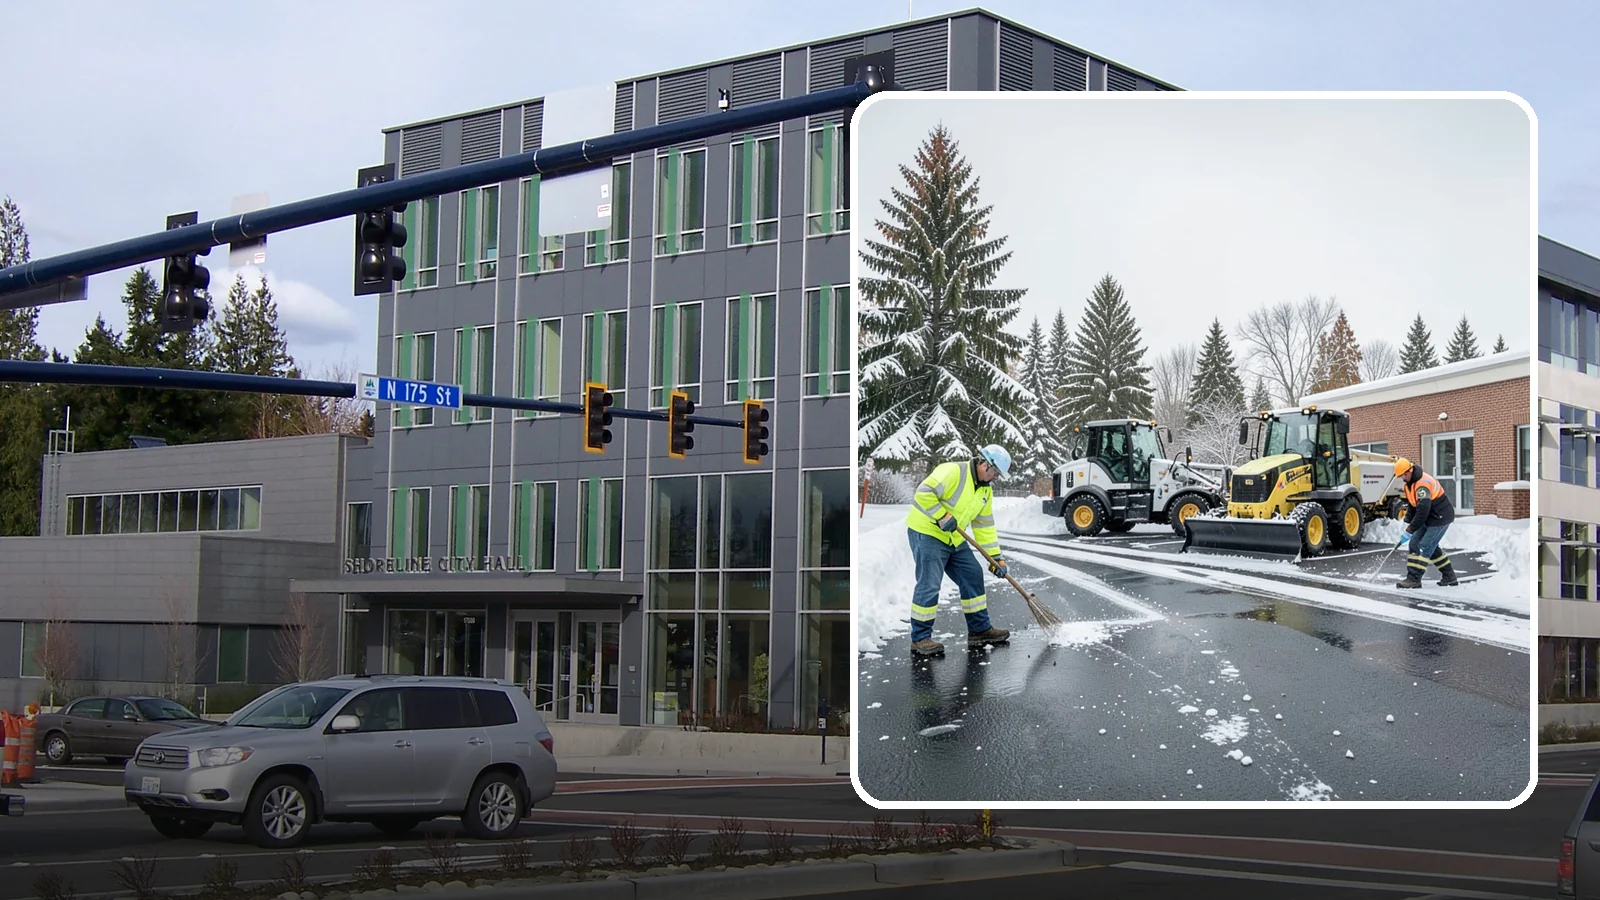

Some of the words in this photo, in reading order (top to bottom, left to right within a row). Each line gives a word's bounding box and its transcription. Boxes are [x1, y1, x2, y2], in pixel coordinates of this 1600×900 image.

[387, 380, 396, 400] N
[405, 382, 427, 403] 175
[436, 386, 451, 406] St
[345, 557, 431, 573] SHORELINE
[438, 556, 476, 572] CITY
[483, 555, 525, 571] HALL
